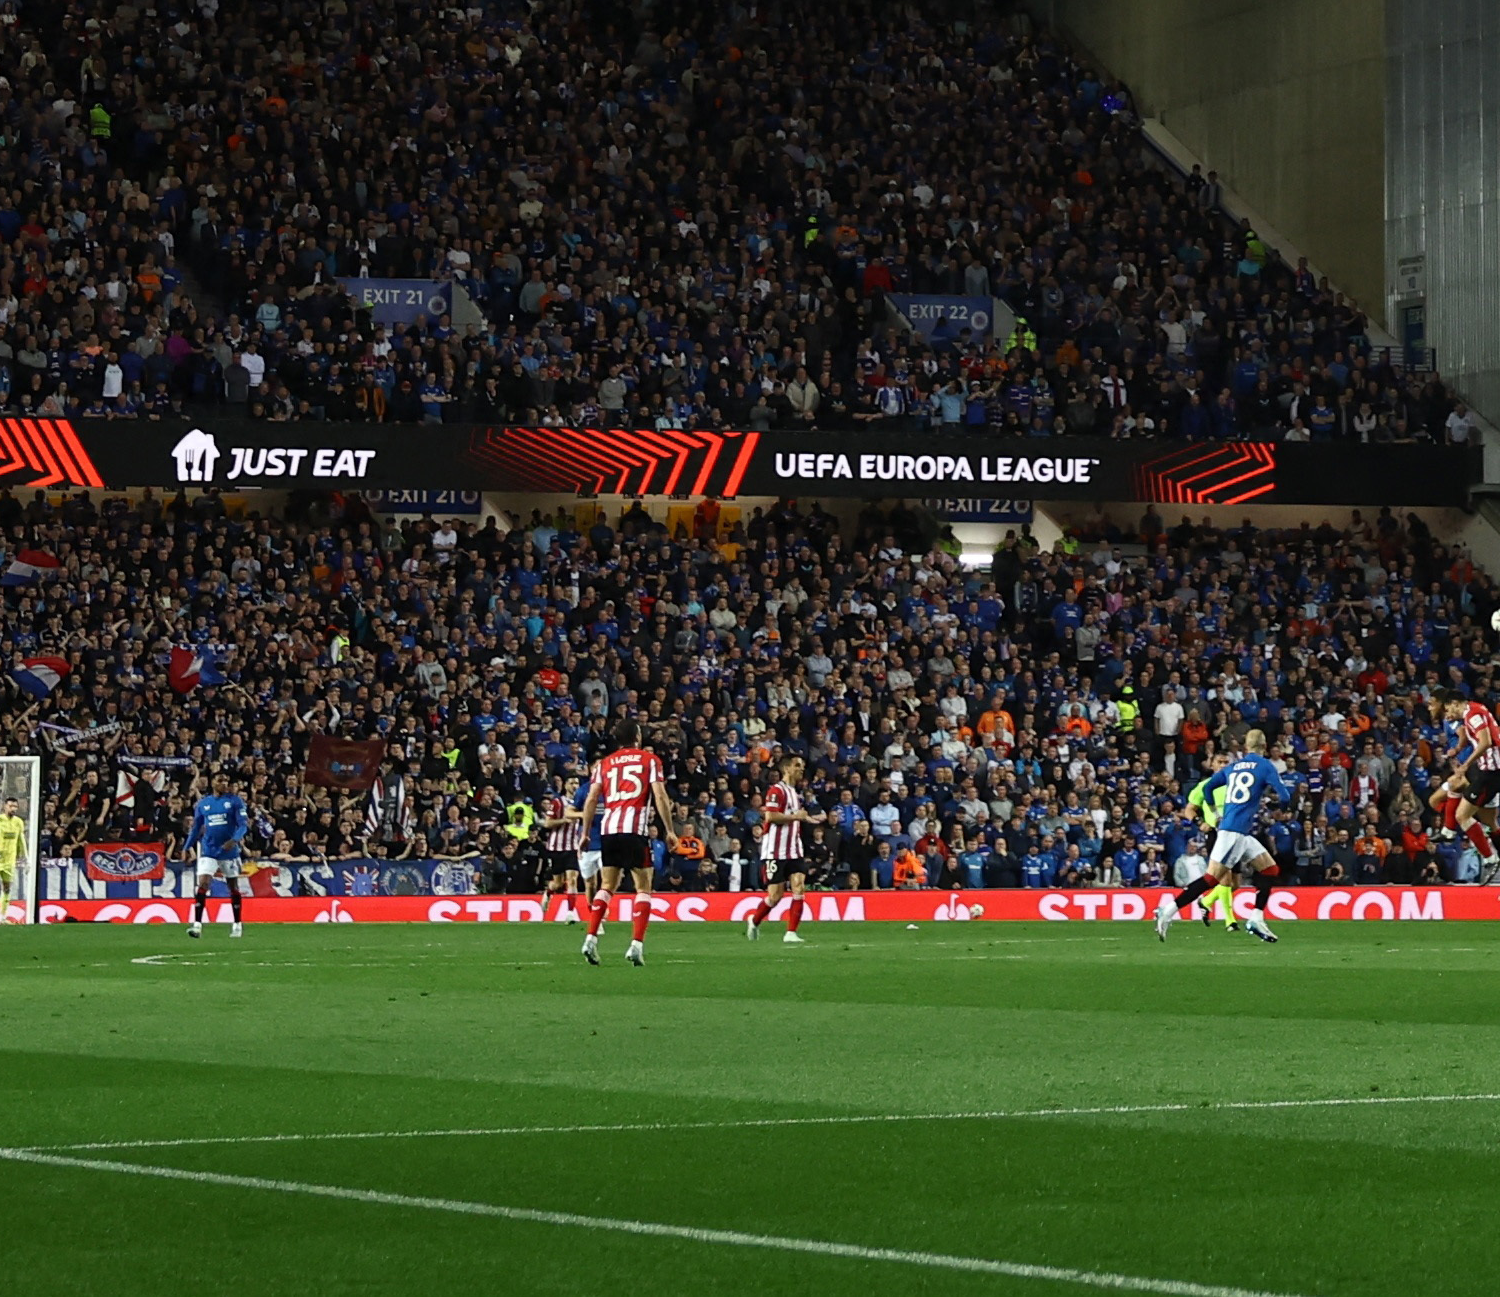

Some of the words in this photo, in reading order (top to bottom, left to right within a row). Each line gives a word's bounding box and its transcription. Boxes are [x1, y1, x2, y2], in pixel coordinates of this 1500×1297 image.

[363, 288, 400, 304] EXIT
[405, 290, 423, 305] 21
[909, 304, 945, 319] EXIT
[949, 305, 968, 319] 22
[227, 447, 307, 480] JUST
[313, 448, 377, 478] EAT
[775, 453, 853, 479] UEFA
[859, 455, 974, 482] EUROPA
[606, 764, 643, 803] 15
[1225, 771, 1255, 804] 18
[766, 859, 778, 872] 16
[428, 897, 710, 922] STRASS
